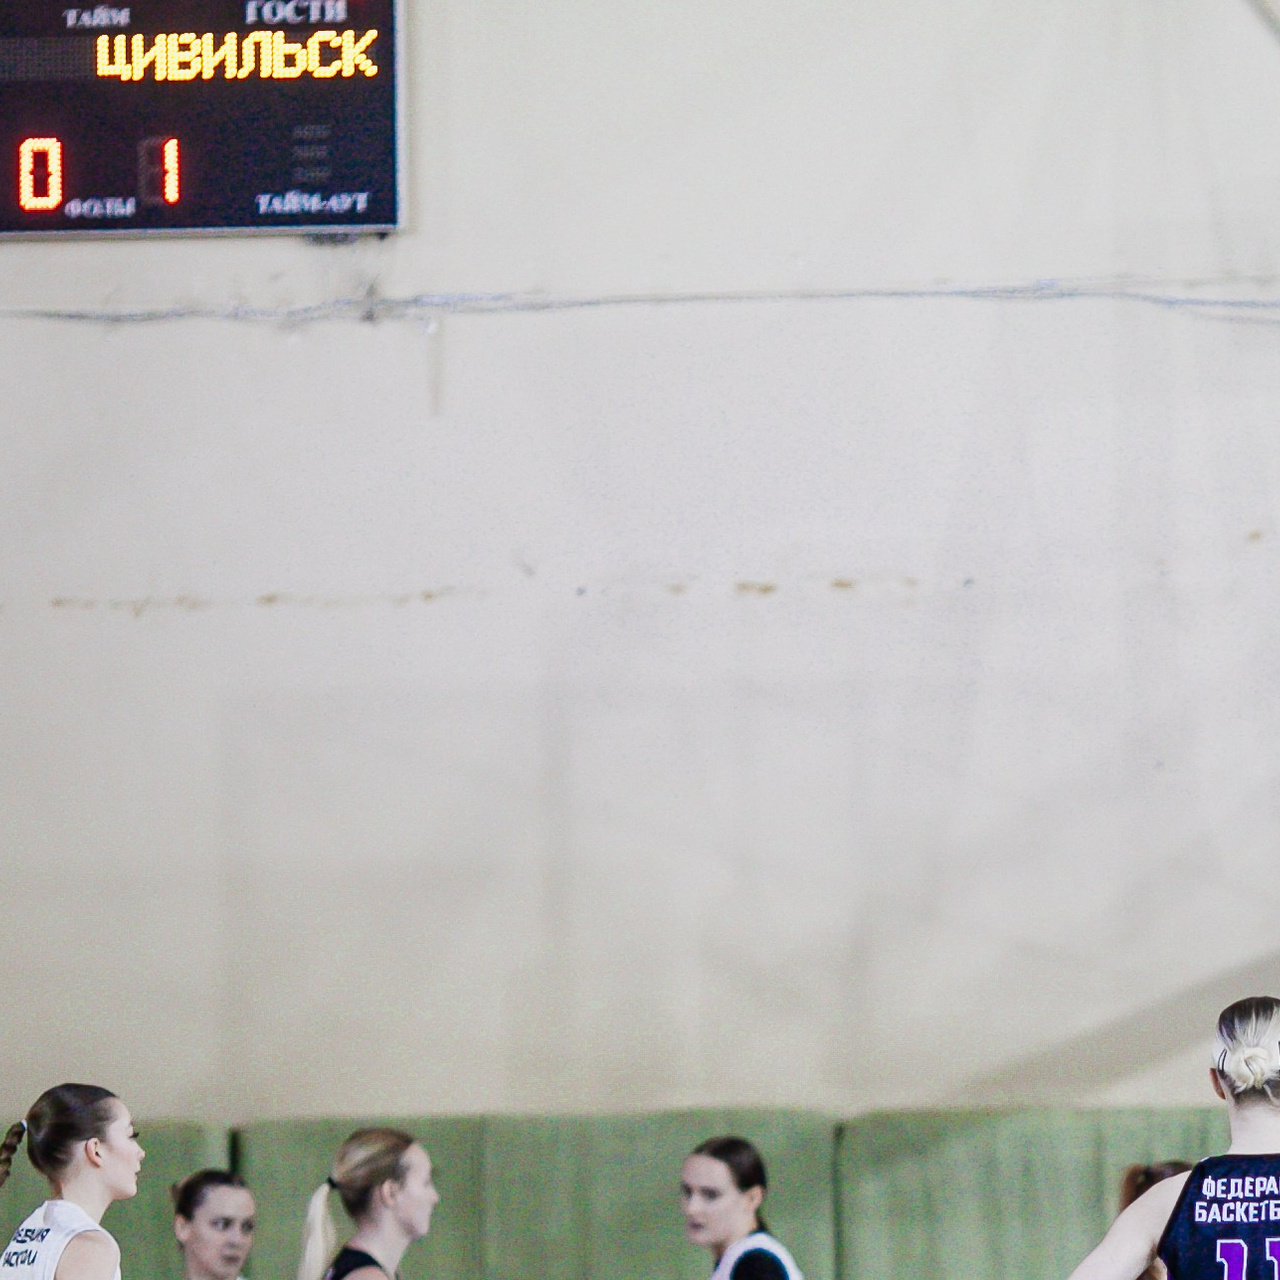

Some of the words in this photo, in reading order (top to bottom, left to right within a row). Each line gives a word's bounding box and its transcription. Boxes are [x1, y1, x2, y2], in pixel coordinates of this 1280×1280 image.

[245, 0, 348, 25] ГОСТИ
[96, 29, 379, 81] ЦИВИЛЬСК
[18, 137, 63, 211] 0
[163, 138, 180, 204] 1
